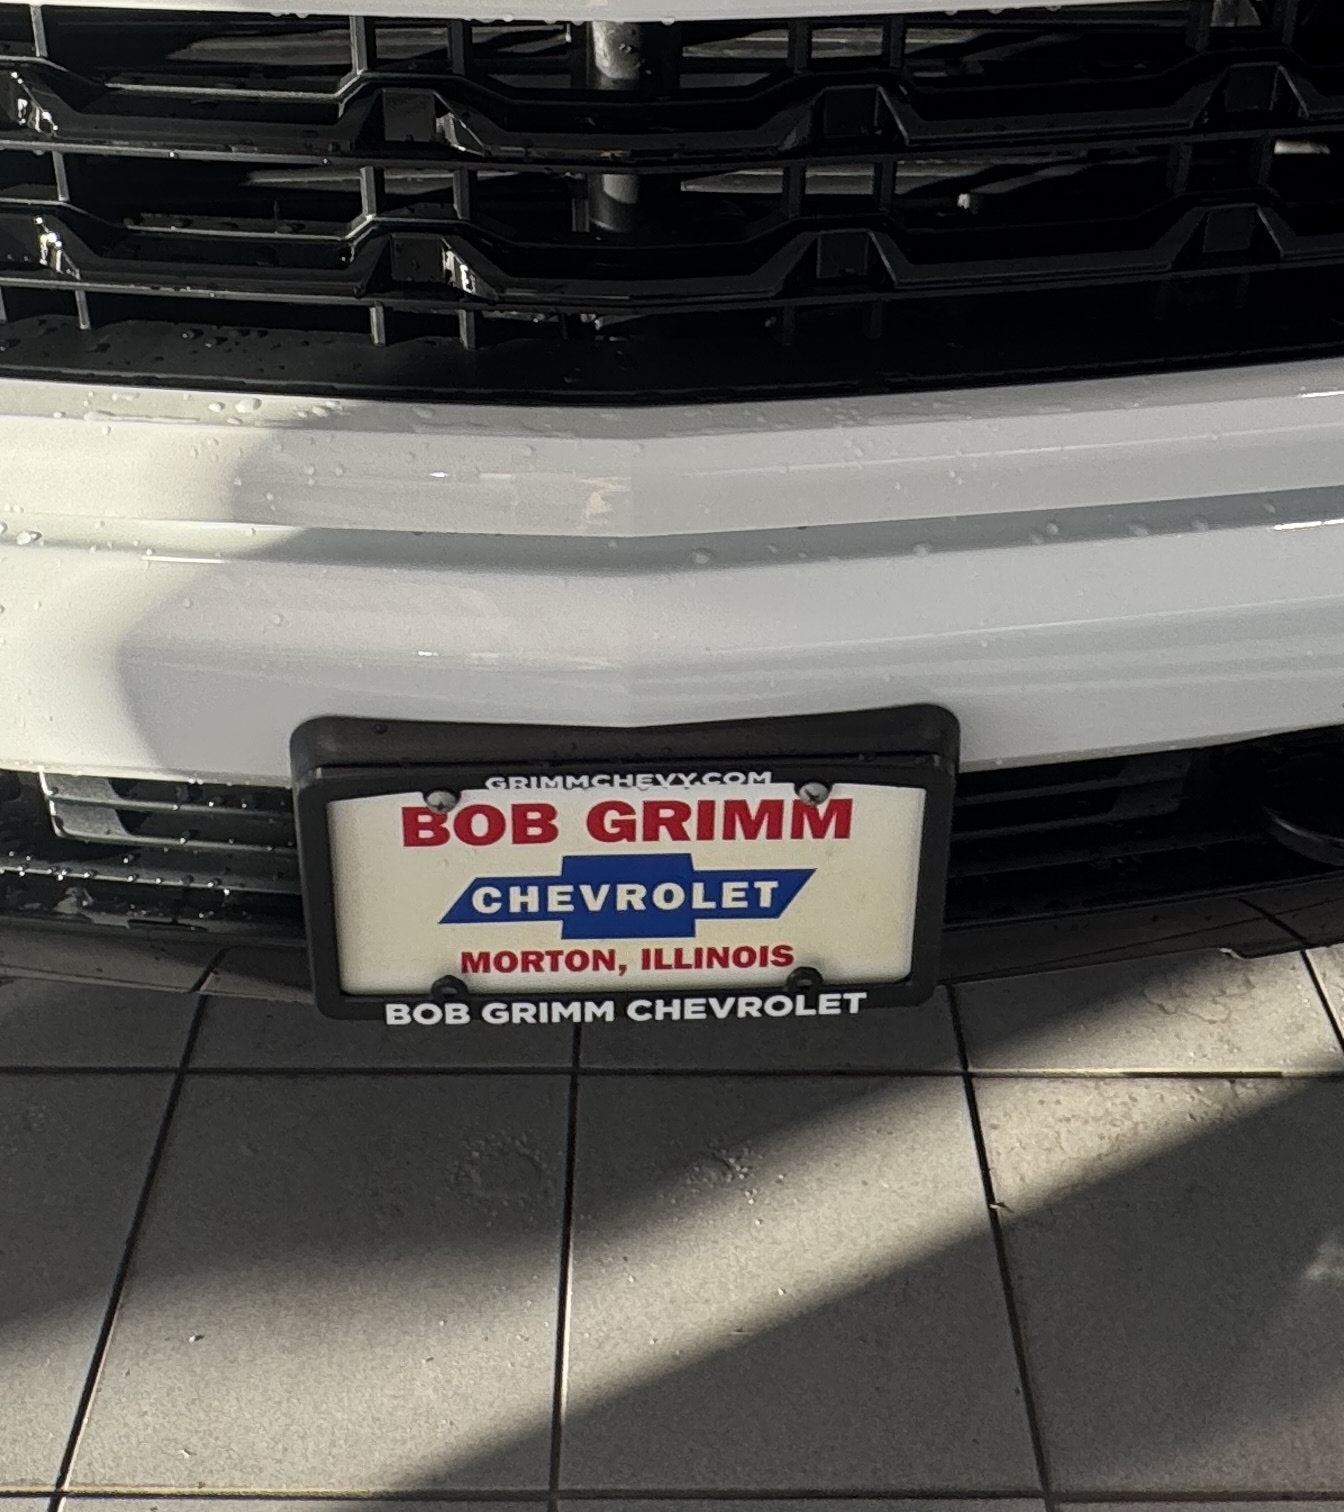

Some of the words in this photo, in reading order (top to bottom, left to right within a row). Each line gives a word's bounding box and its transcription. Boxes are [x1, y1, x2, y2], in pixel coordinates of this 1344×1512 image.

[485, 771, 772, 790] GRIMMCHEVY.COM
[402, 803, 559, 847] BOB
[586, 799, 853, 843] GRIMM
[471, 881, 778, 913] CHEVROLET
[461, 950, 628, 976] MORTON,
[641, 945, 794, 970] ILLINOIS
[385, 1003, 471, 1025] BOB
[481, 1000, 615, 1025] GRIMM
[626, 992, 868, 1021] CHEVROLET
